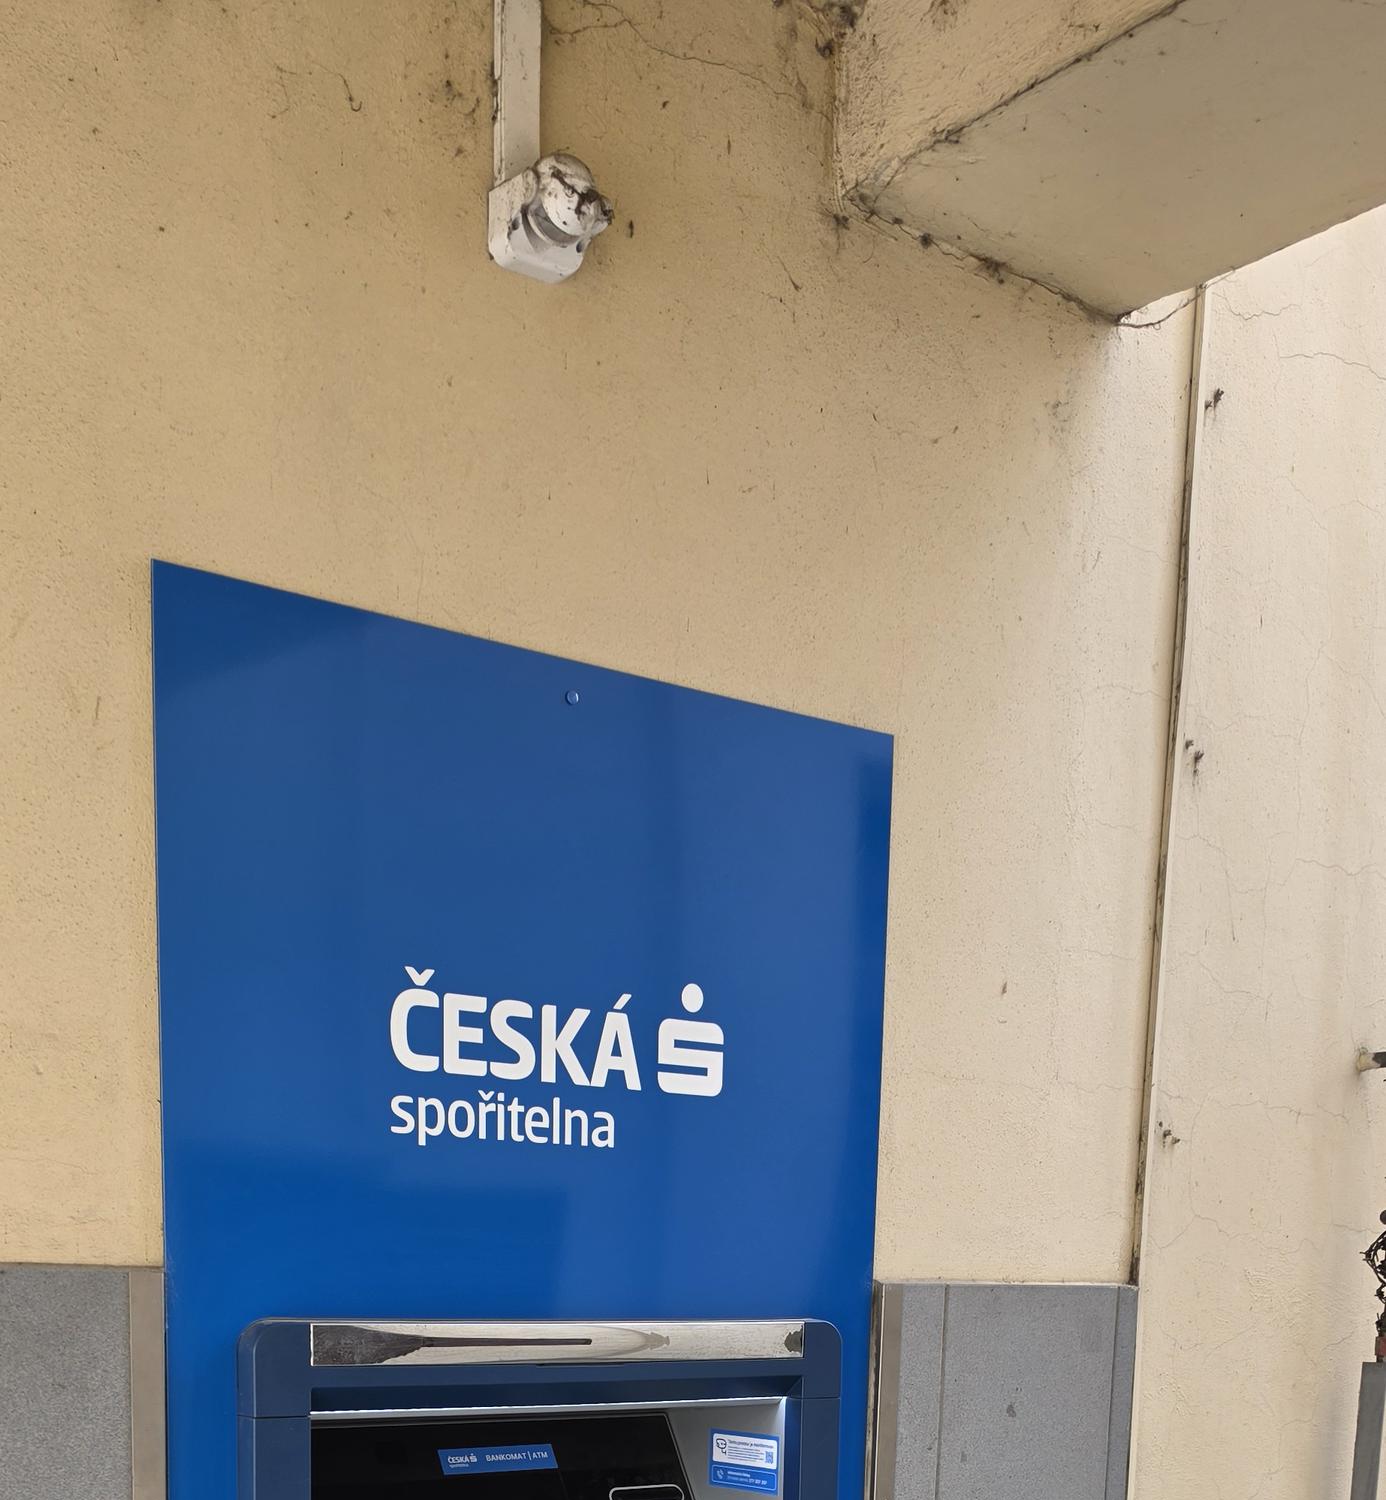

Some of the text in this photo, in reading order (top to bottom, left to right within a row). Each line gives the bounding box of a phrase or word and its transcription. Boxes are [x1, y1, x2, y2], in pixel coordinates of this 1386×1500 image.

[390, 965, 642, 1091] ČESKÁ
[390, 1090, 616, 1149] spořitelna
[485, 1451, 548, 1462] BANKOMAT ATM
